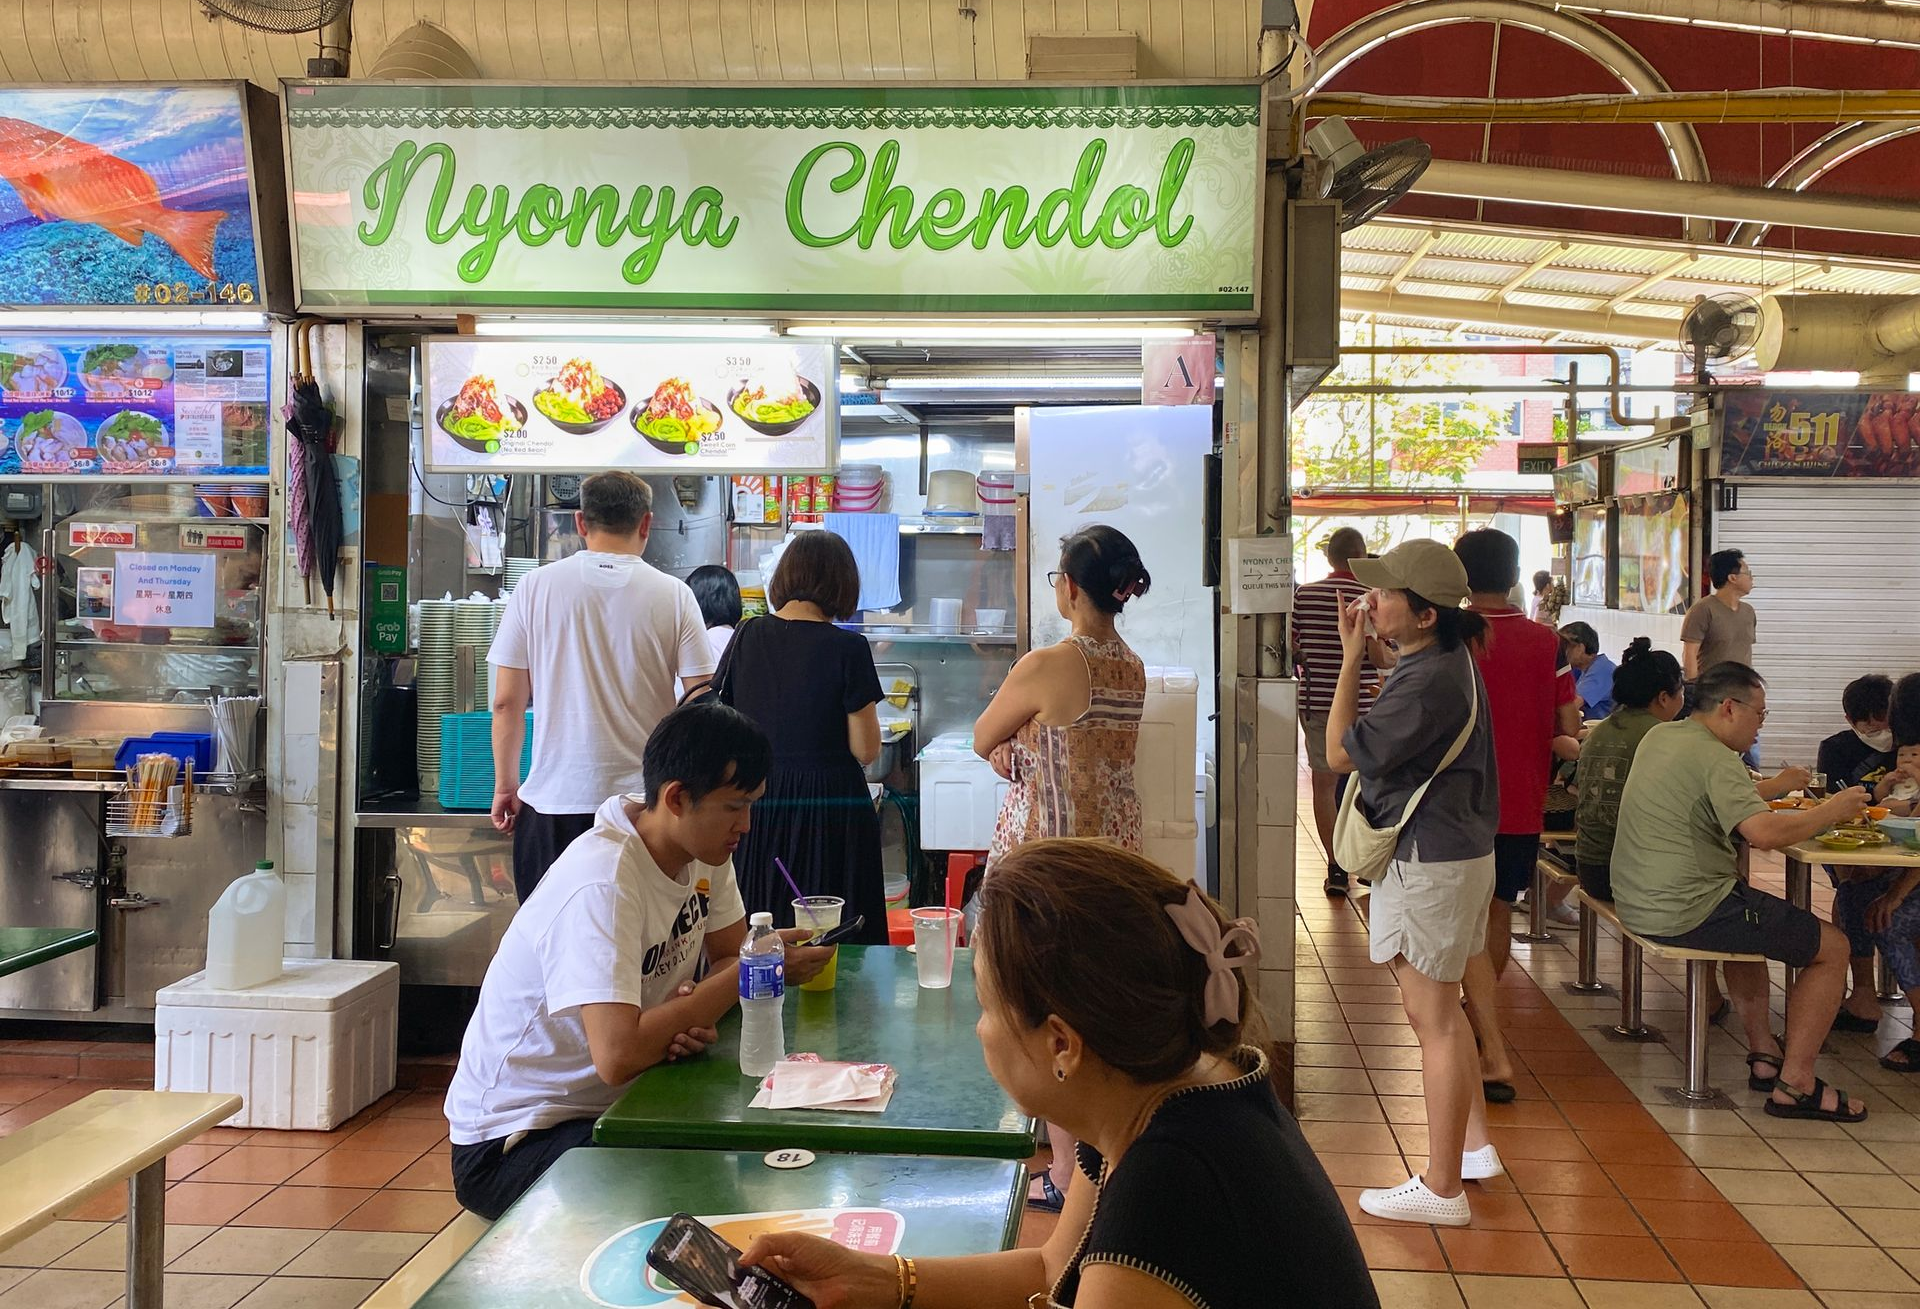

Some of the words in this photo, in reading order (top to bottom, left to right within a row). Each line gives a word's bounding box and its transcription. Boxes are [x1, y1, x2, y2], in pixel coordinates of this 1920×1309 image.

[357, 139, 740, 285] Nyonya
[784, 137, 1197, 251] Chendol
[134, 281, 255, 304] #02-146
[1163, 355, 1196, 388] A
[1788, 412, 1840, 447] 511
[1523, 460, 1546, 473] EXIT
[129, 563, 157, 572] Closed
[170, 564, 201, 574] Monday
[138, 577, 156, 585] And
[156, 577, 191, 586] Thursday
[135, 590, 162, 599] 星期一
[167, 590, 193, 600] 星期四
[155, 604, 173, 614] 休息
[376, 621, 401, 632] Grab
[379, 631, 398, 643] Pay
[776, 1153, 801, 1163] 18
